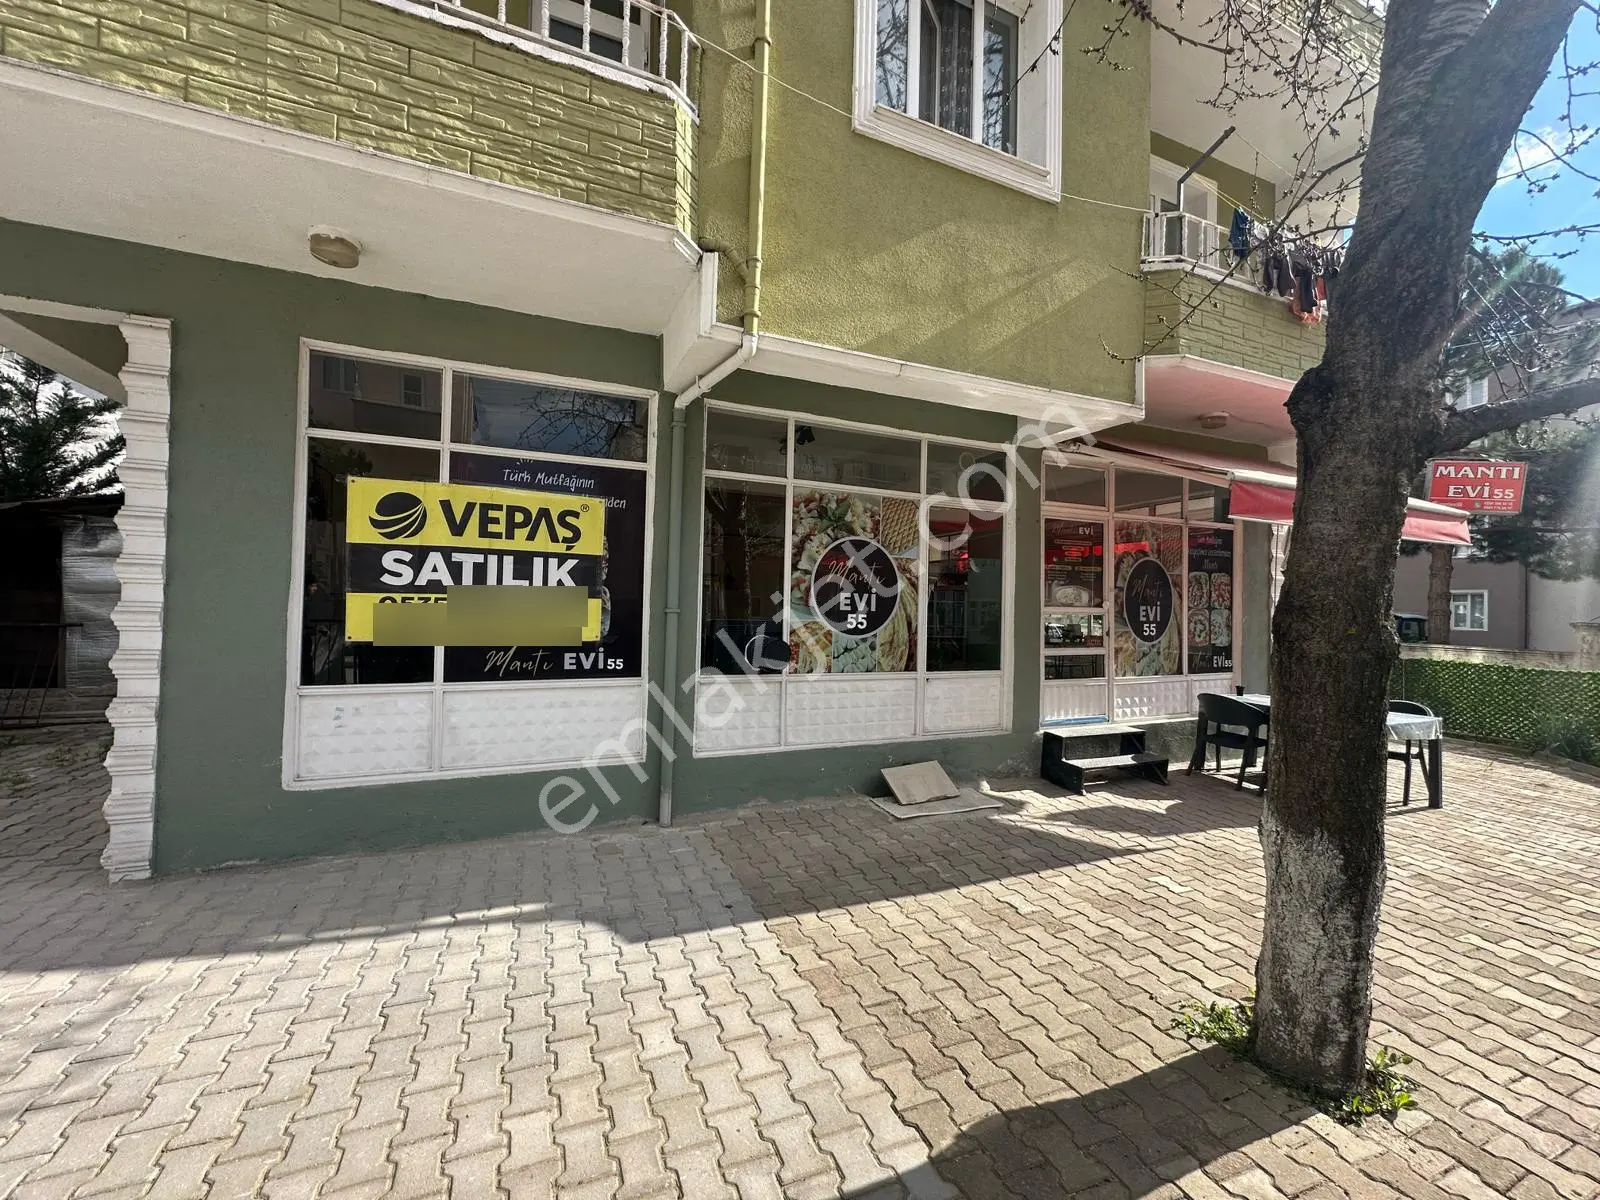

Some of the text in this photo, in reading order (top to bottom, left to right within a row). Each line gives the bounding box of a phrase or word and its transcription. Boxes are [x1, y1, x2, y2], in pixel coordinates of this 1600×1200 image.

[503, 469, 595, 492] Türk Mutfağının
[1435, 466, 1520, 479] MANTI
[1448, 482, 1514, 499] EVİ 55
[438, 500, 582, 552] VEPAŞ
[380, 550, 580, 587] SATILIK
[846, 613, 868, 629] 55
[1143, 623, 1157, 636] 55
[607, 658, 624, 670] 55
